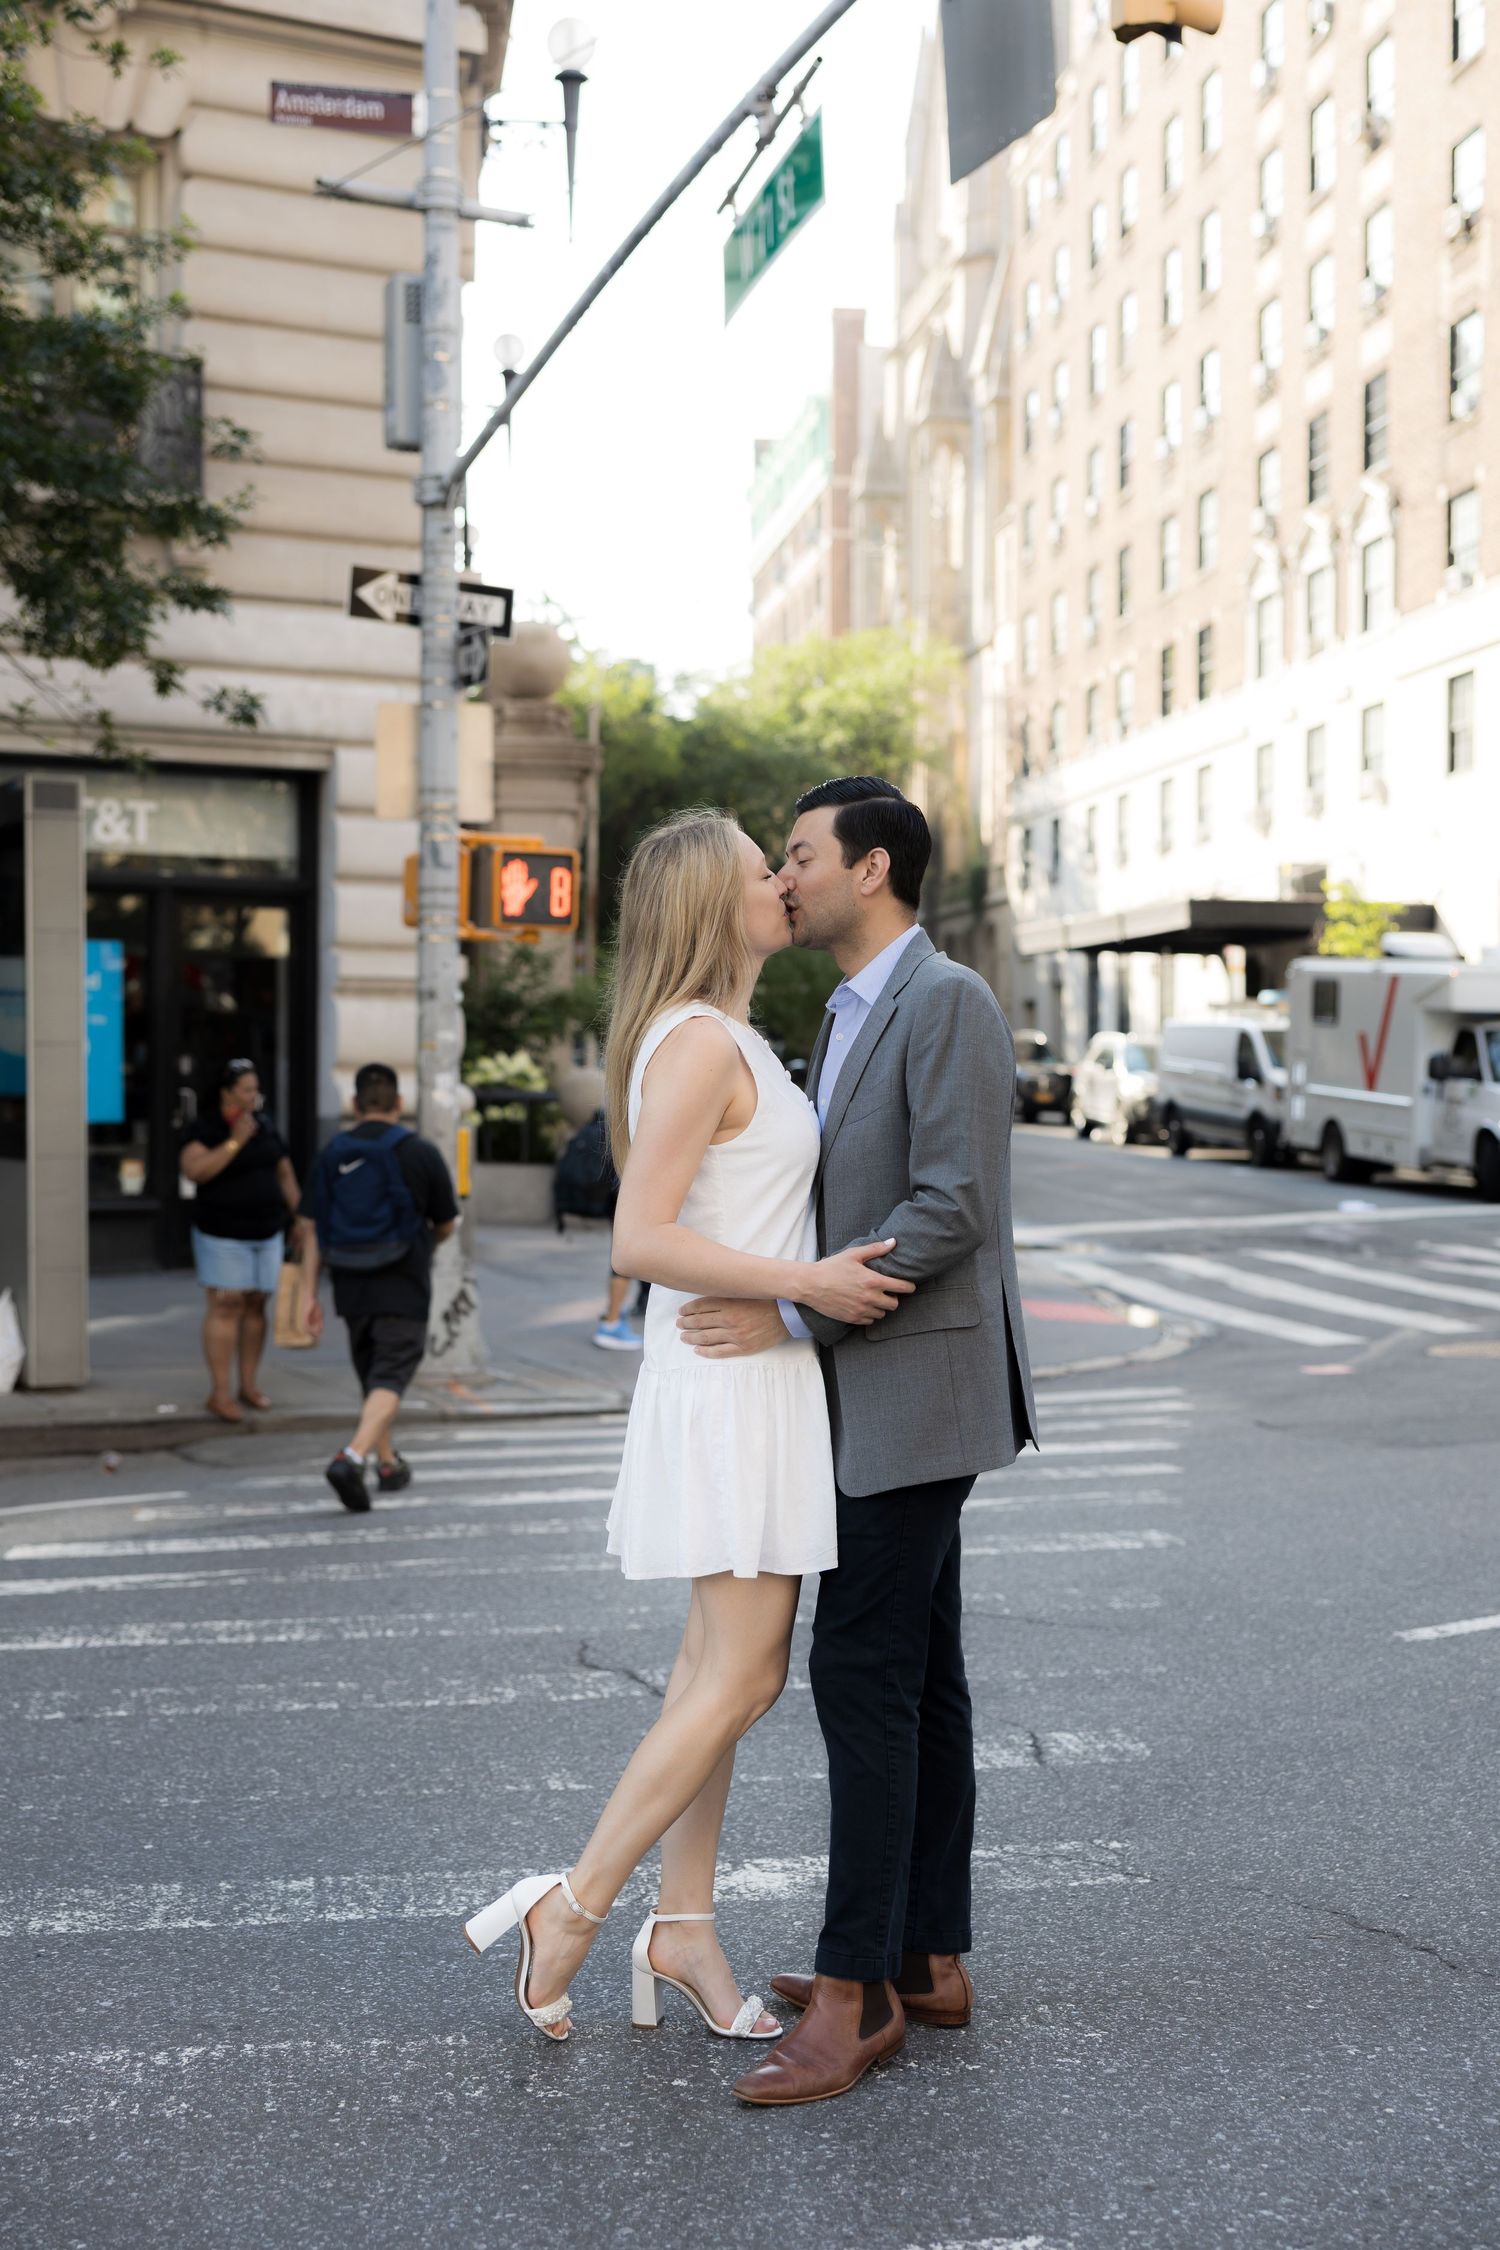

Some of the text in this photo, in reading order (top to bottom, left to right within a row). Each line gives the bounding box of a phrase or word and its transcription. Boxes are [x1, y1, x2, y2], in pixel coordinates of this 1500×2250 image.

[275, 88, 385, 121] Amsterdam
[456, 594, 493, 617] AY
[549, 865, 572, 918] 8
